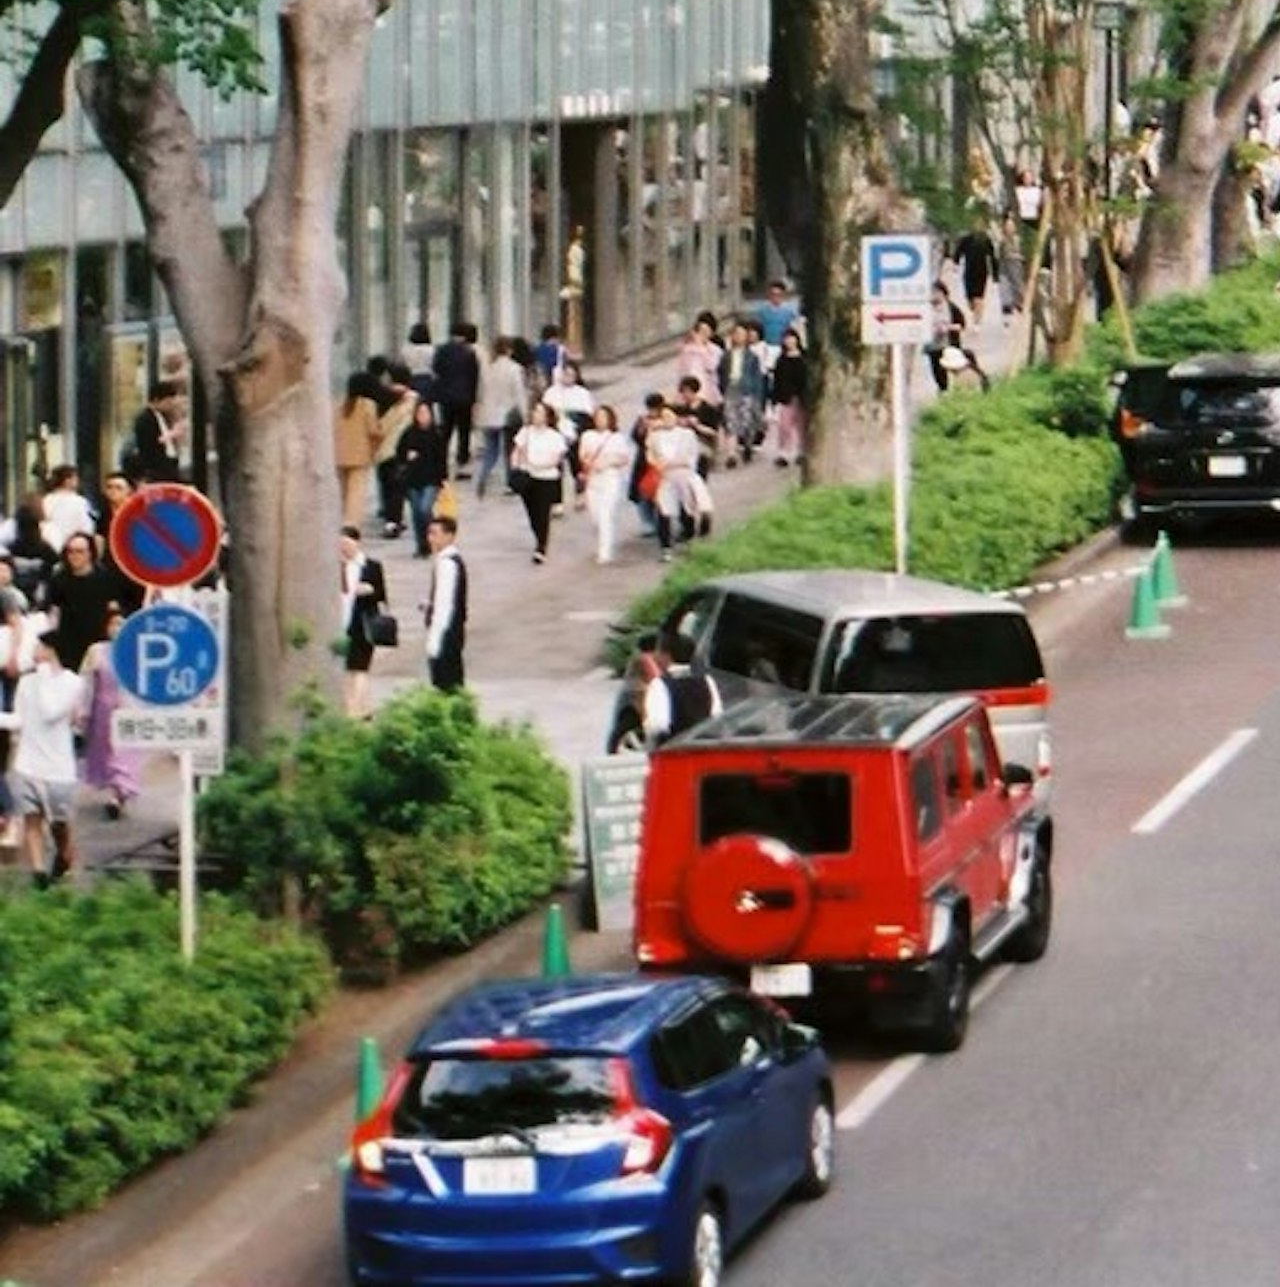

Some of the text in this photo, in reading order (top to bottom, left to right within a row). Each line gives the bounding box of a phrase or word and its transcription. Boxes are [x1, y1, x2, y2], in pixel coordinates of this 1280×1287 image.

[868, 243, 922, 295] P
[137, 633, 178, 696] P
[166, 666, 197, 697] 60
